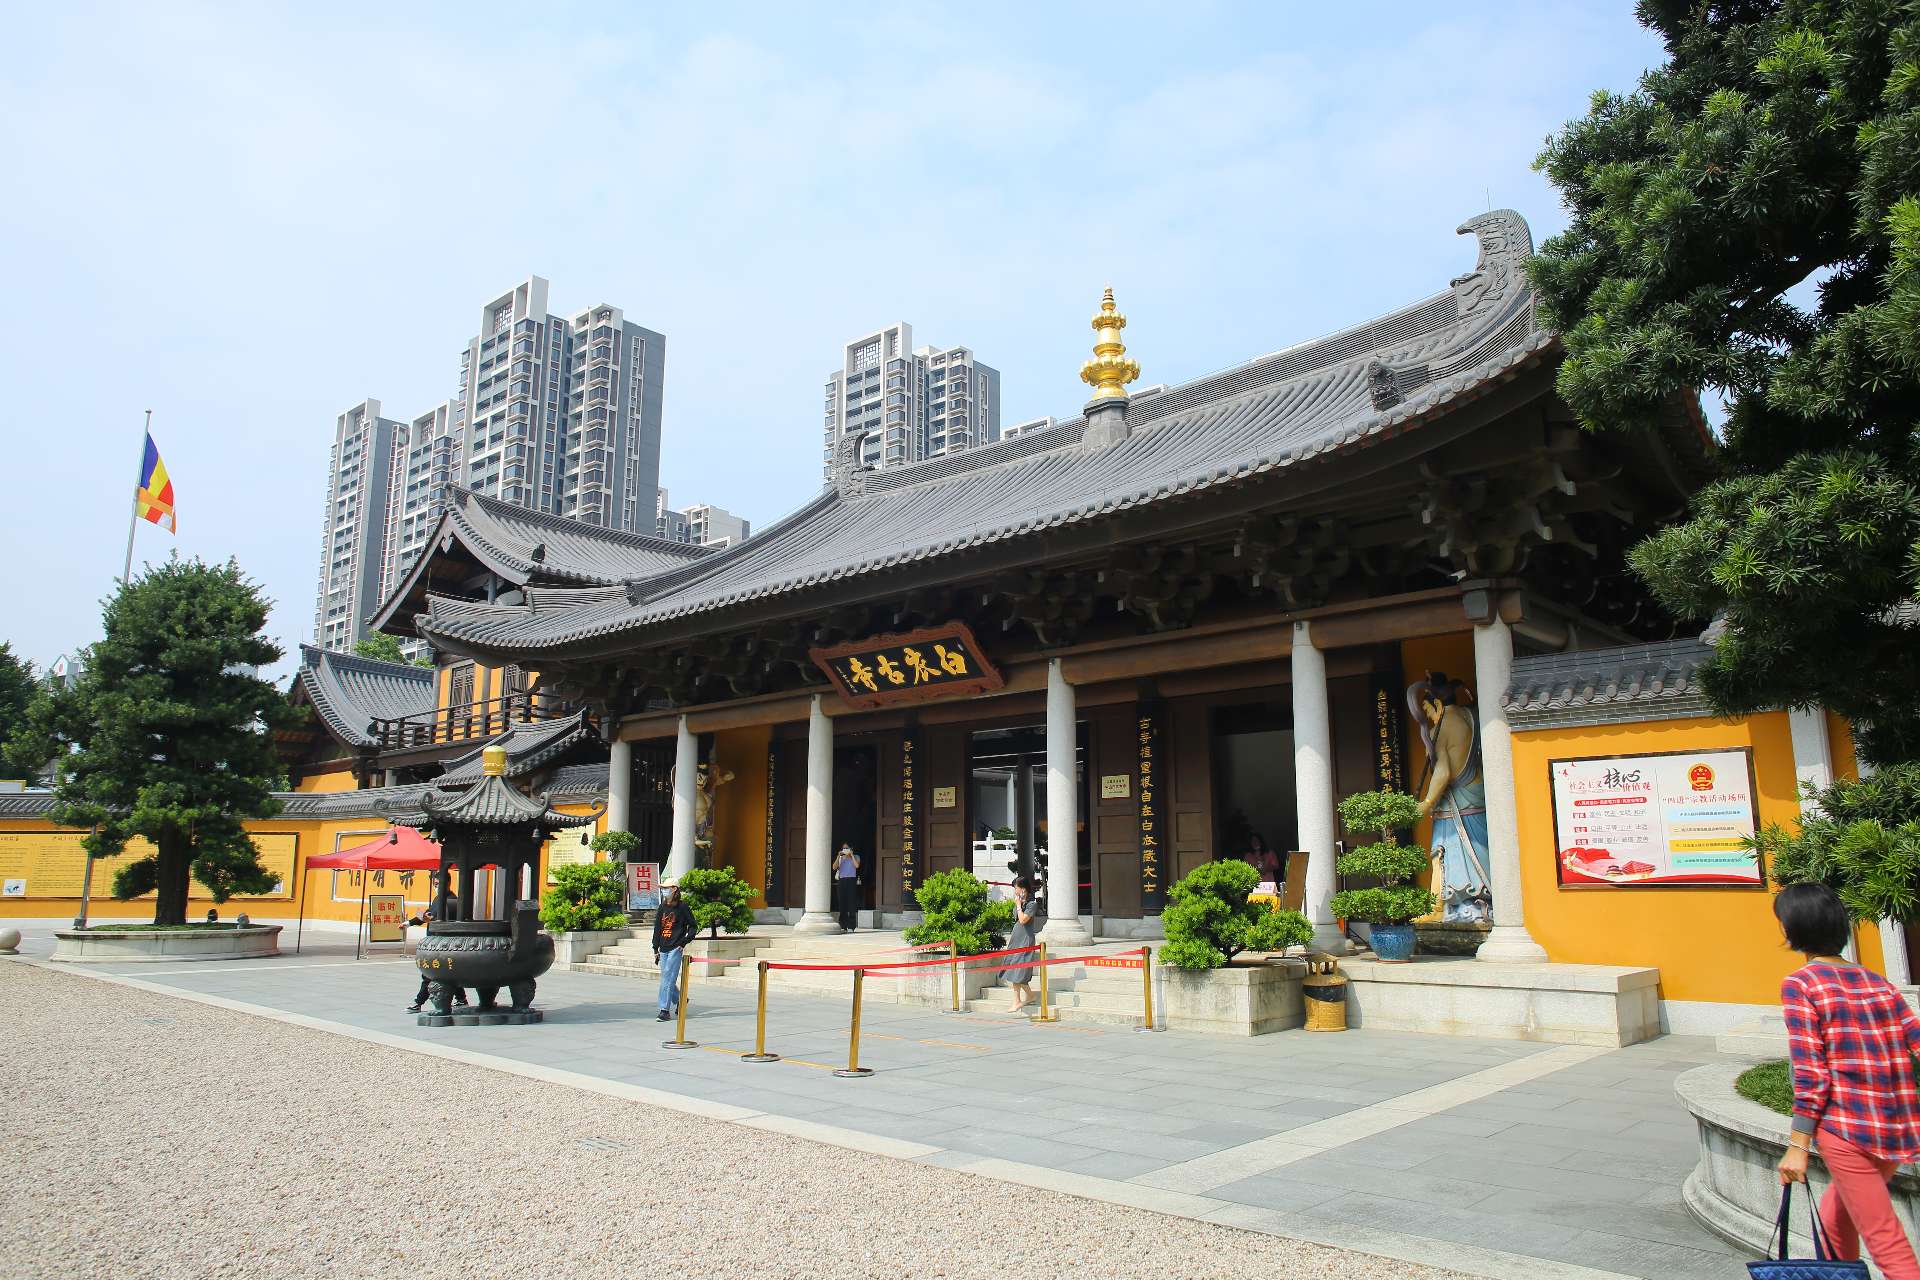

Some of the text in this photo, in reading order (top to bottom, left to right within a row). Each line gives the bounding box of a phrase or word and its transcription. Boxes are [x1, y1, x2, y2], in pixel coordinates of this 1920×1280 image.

[636, 865, 651, 891] 出口
[377, 901, 396, 912] 临时
[373, 913, 401, 925] 隔离点
